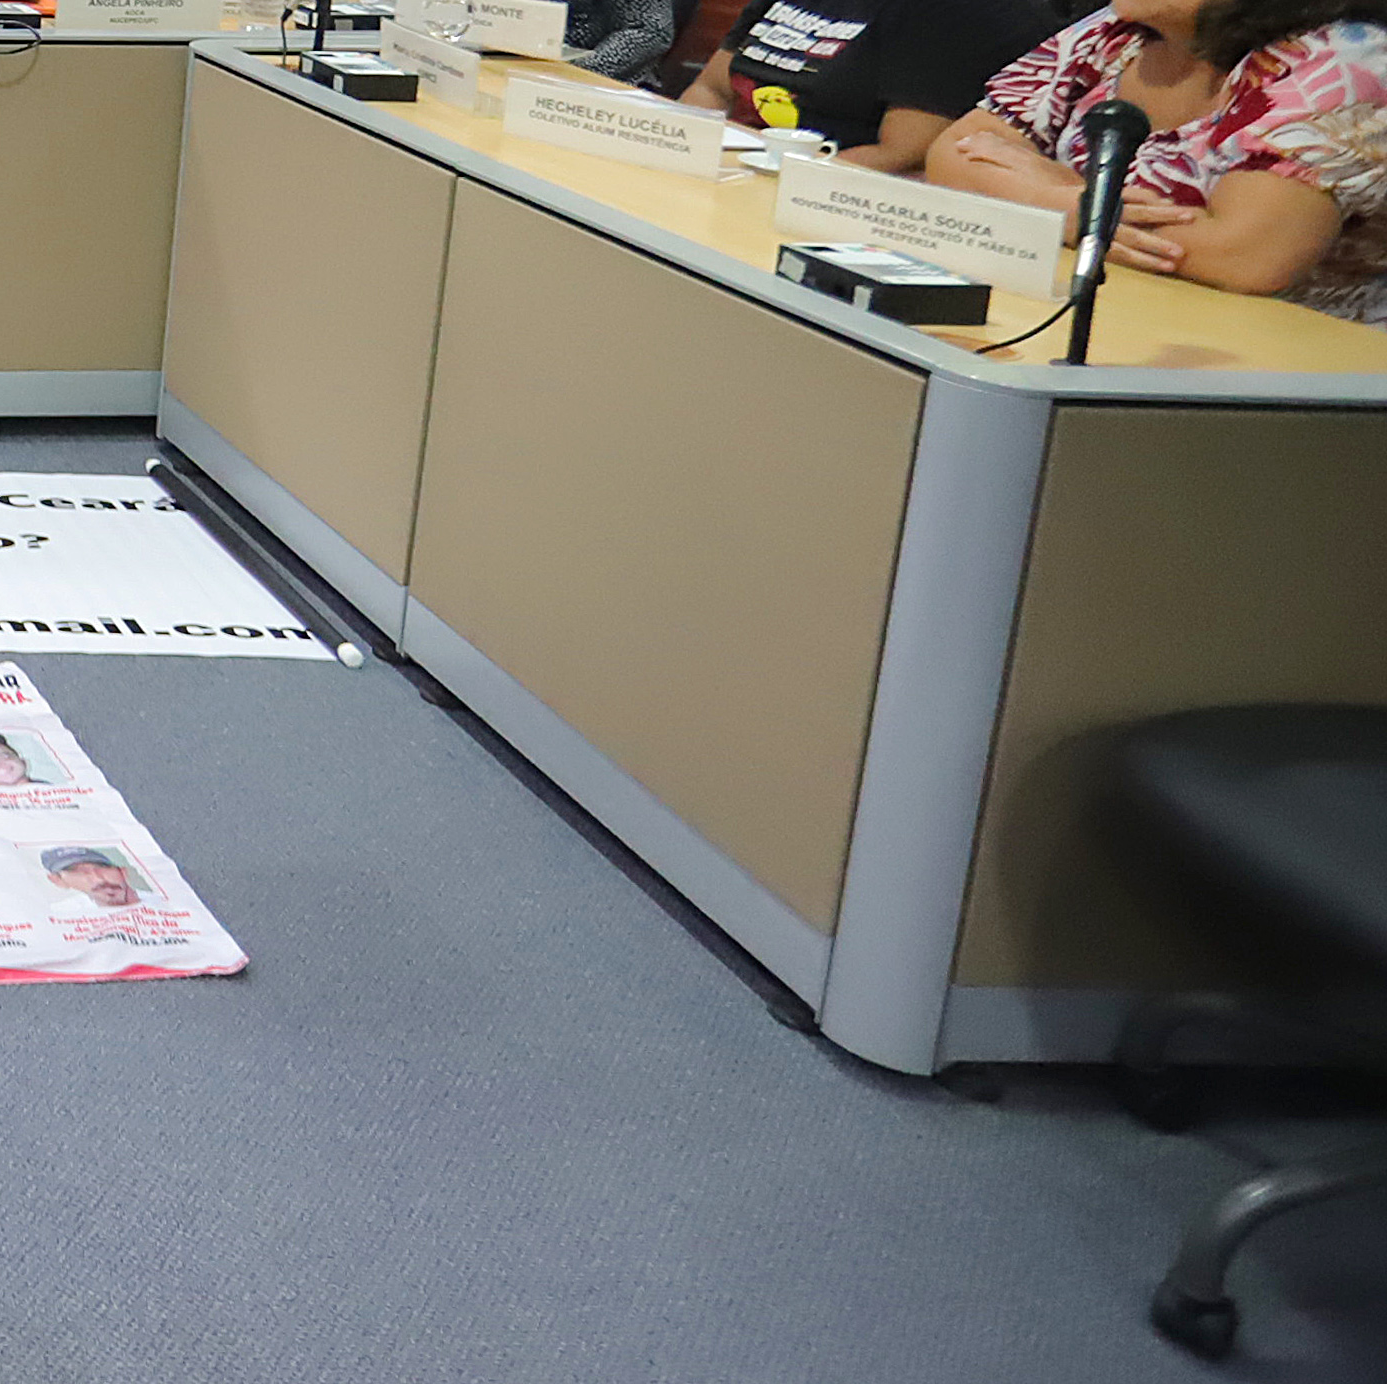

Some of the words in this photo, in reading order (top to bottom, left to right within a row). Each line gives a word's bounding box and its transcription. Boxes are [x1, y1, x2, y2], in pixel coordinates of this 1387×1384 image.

[481, 3, 524, 20] MONTE
[528, 110, 579, 128] COLETIVO
[535, 97, 615, 123] HECHELEY
[619, 114, 687, 140] LUCÉLIA
[791, 197, 860, 218] MOVIMENTO
[899, 221, 917, 233] DO
[966, 236, 974, 247] E
[1018, 249, 1037, 261] DA
[829, 191, 870, 210] EDNA
[877, 201, 928, 223] CARLA
[935, 214, 993, 238] SOUZA
